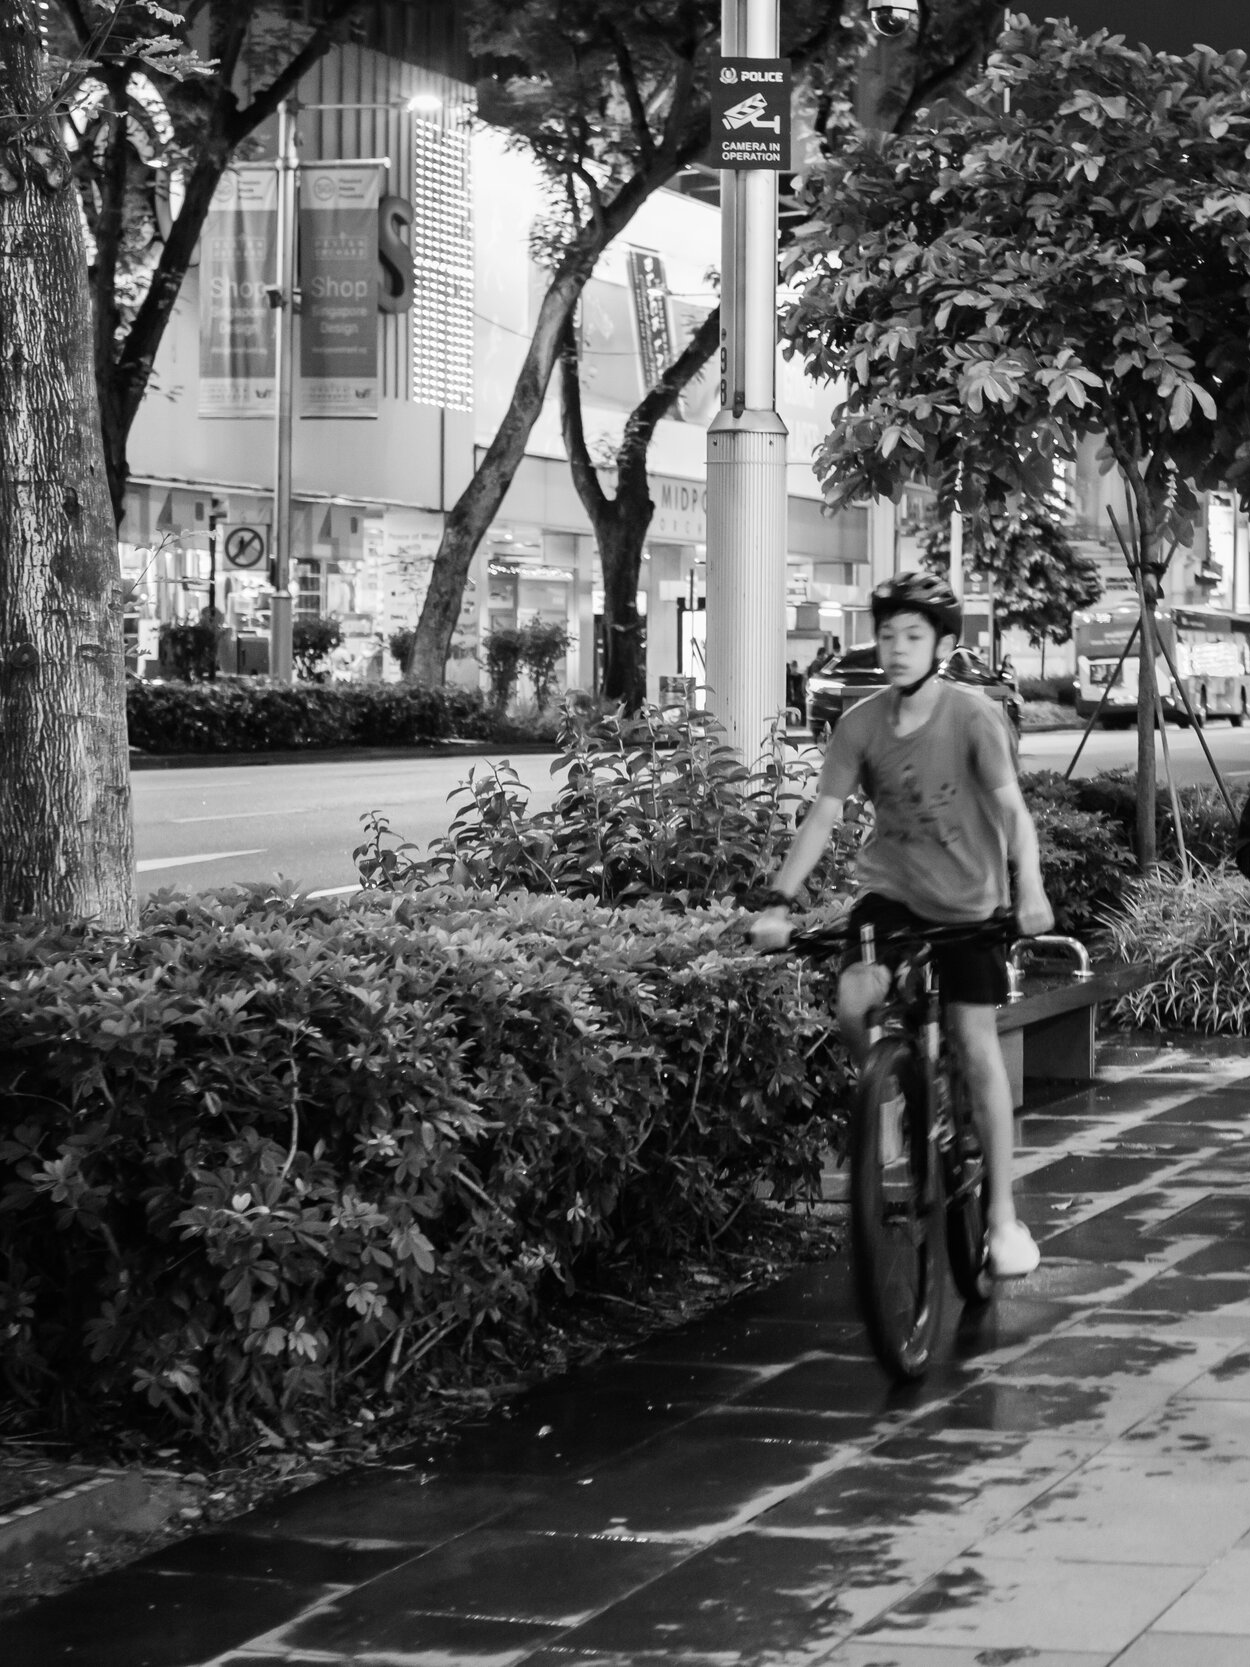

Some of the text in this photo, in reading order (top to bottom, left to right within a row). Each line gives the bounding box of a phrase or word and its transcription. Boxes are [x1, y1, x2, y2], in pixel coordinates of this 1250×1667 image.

[741, 71, 784, 82] POLICE
[722, 142, 780, 151] CAMERA IN
[722, 152, 780, 161] OPERATION
[311, 276, 368, 301] Shop
